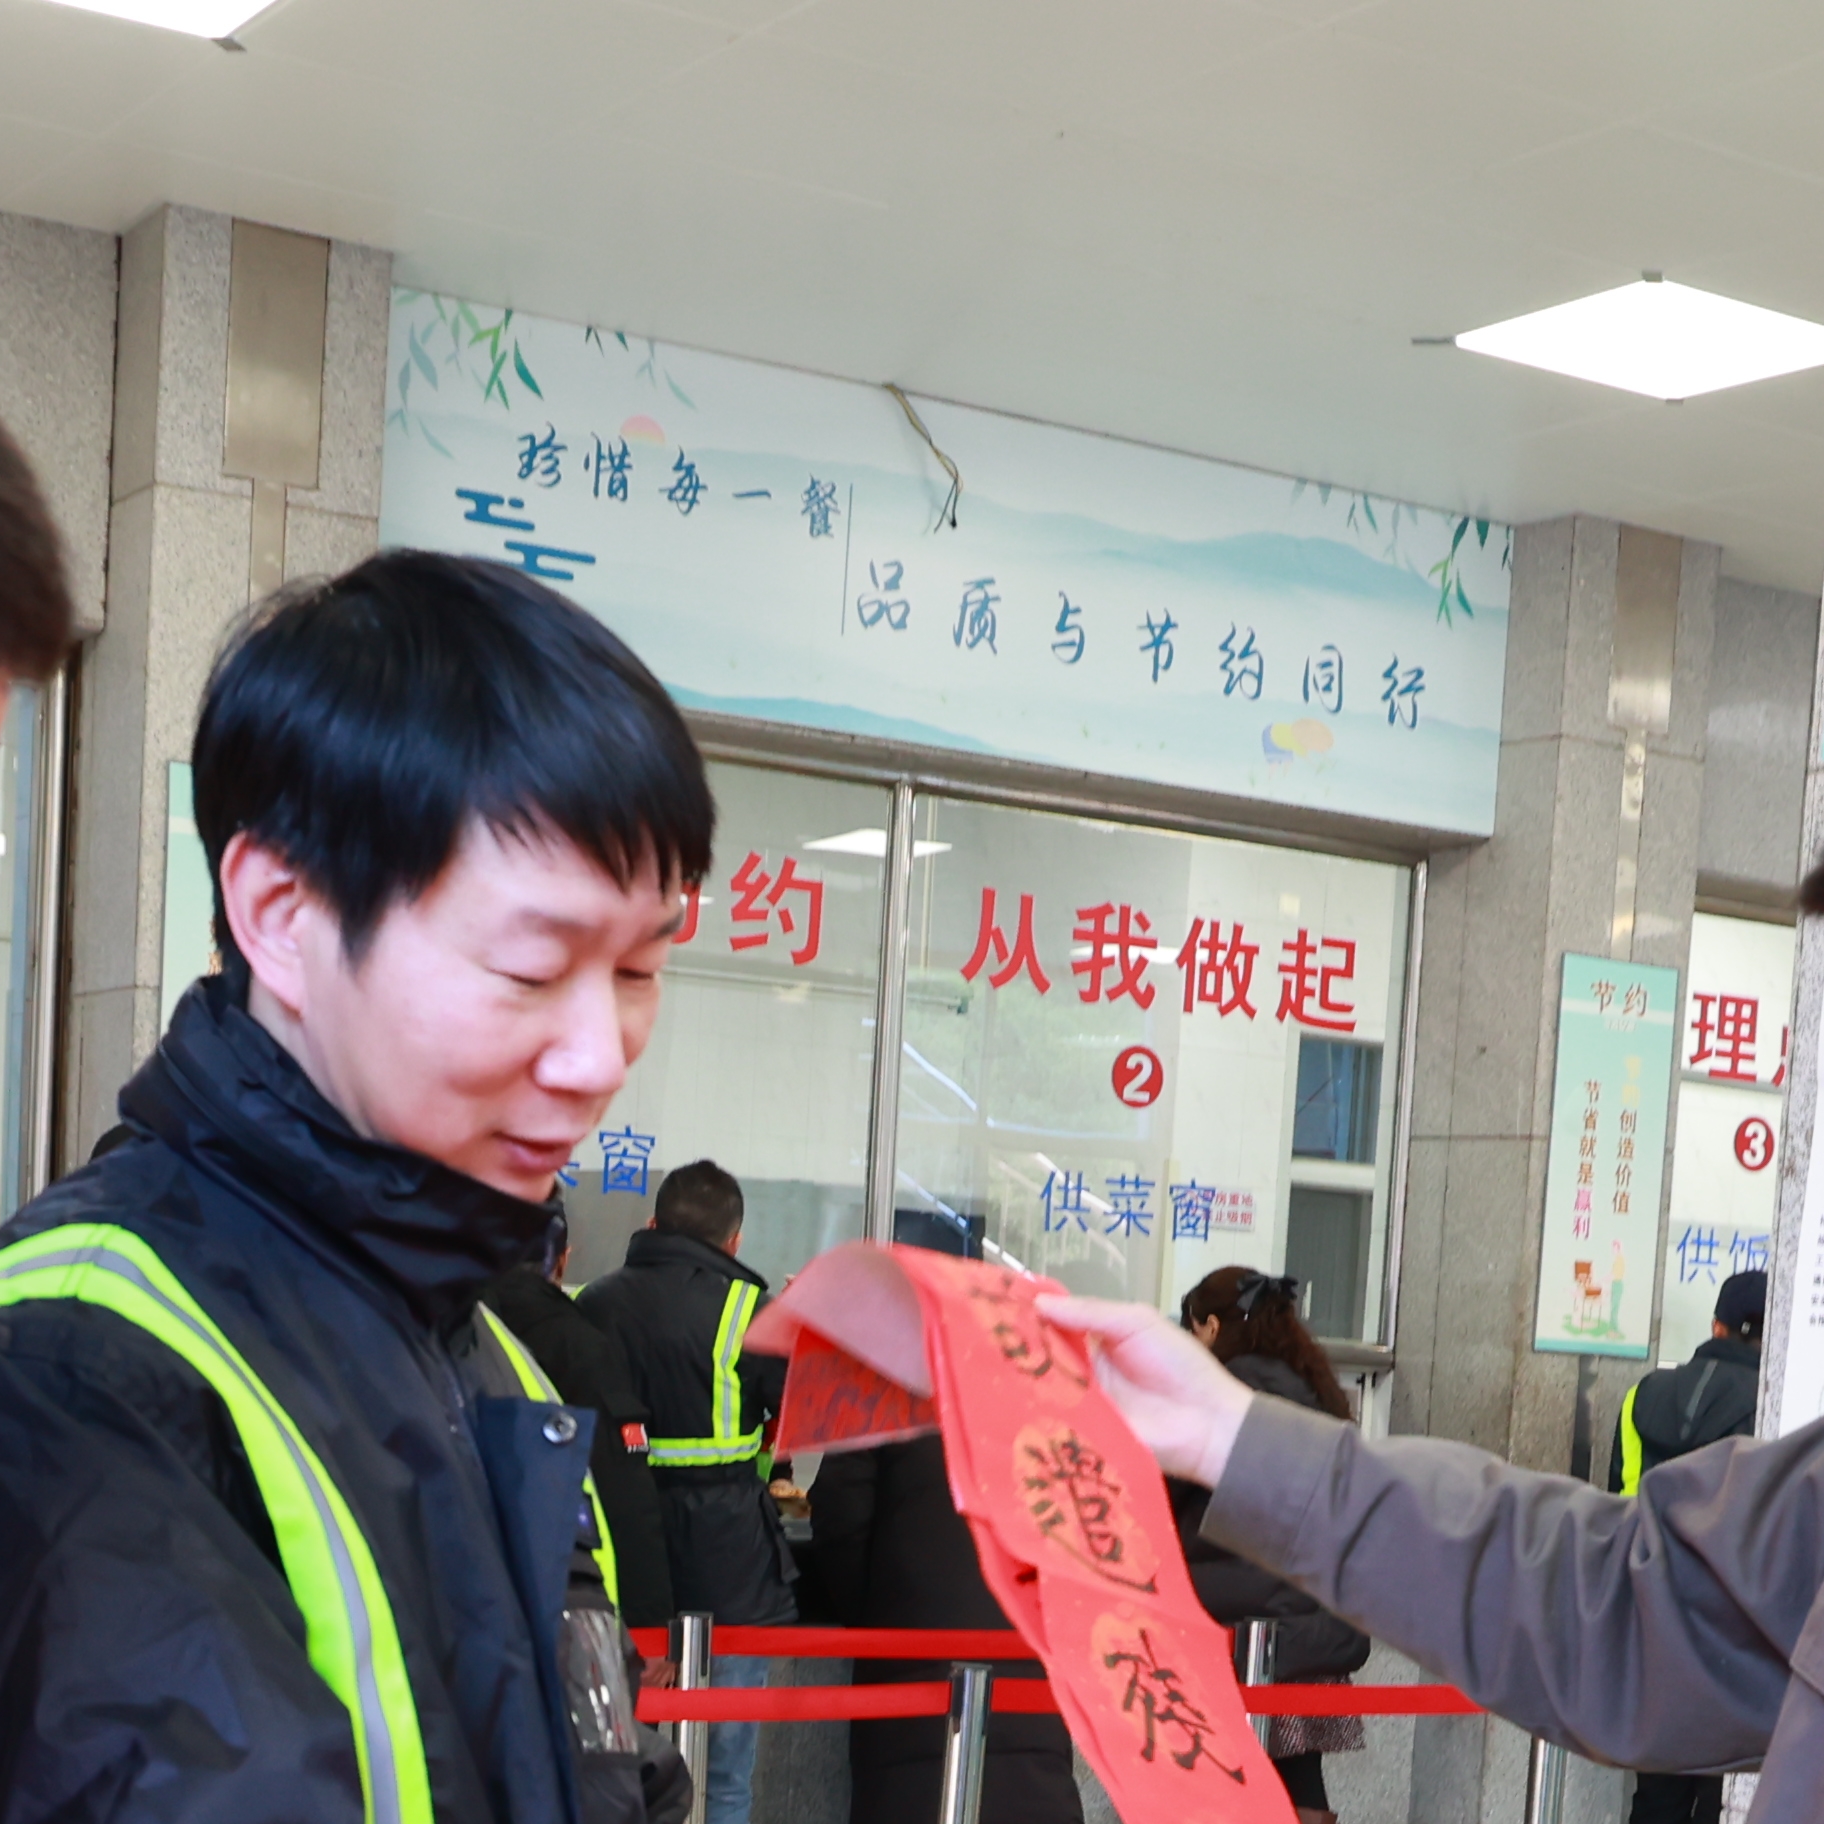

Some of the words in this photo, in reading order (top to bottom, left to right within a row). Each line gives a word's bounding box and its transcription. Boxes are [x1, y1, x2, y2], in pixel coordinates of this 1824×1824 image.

[516, 422, 842, 541] 珍惜每一餐
[856, 560, 1428, 731] 品质与节约同行
[673, 850, 826, 966] 约
[960, 886, 1358, 1034] 从我做起
[1590, 978, 1649, 1019] 节约
[1688, 991, 1789, 1088] 理
[1121, 1053, 1155, 1103] 2
[557, 1123, 657, 1198] 窗
[1741, 1123, 1768, 1165] 3
[1039, 1170, 1218, 1243] 供菜窗
